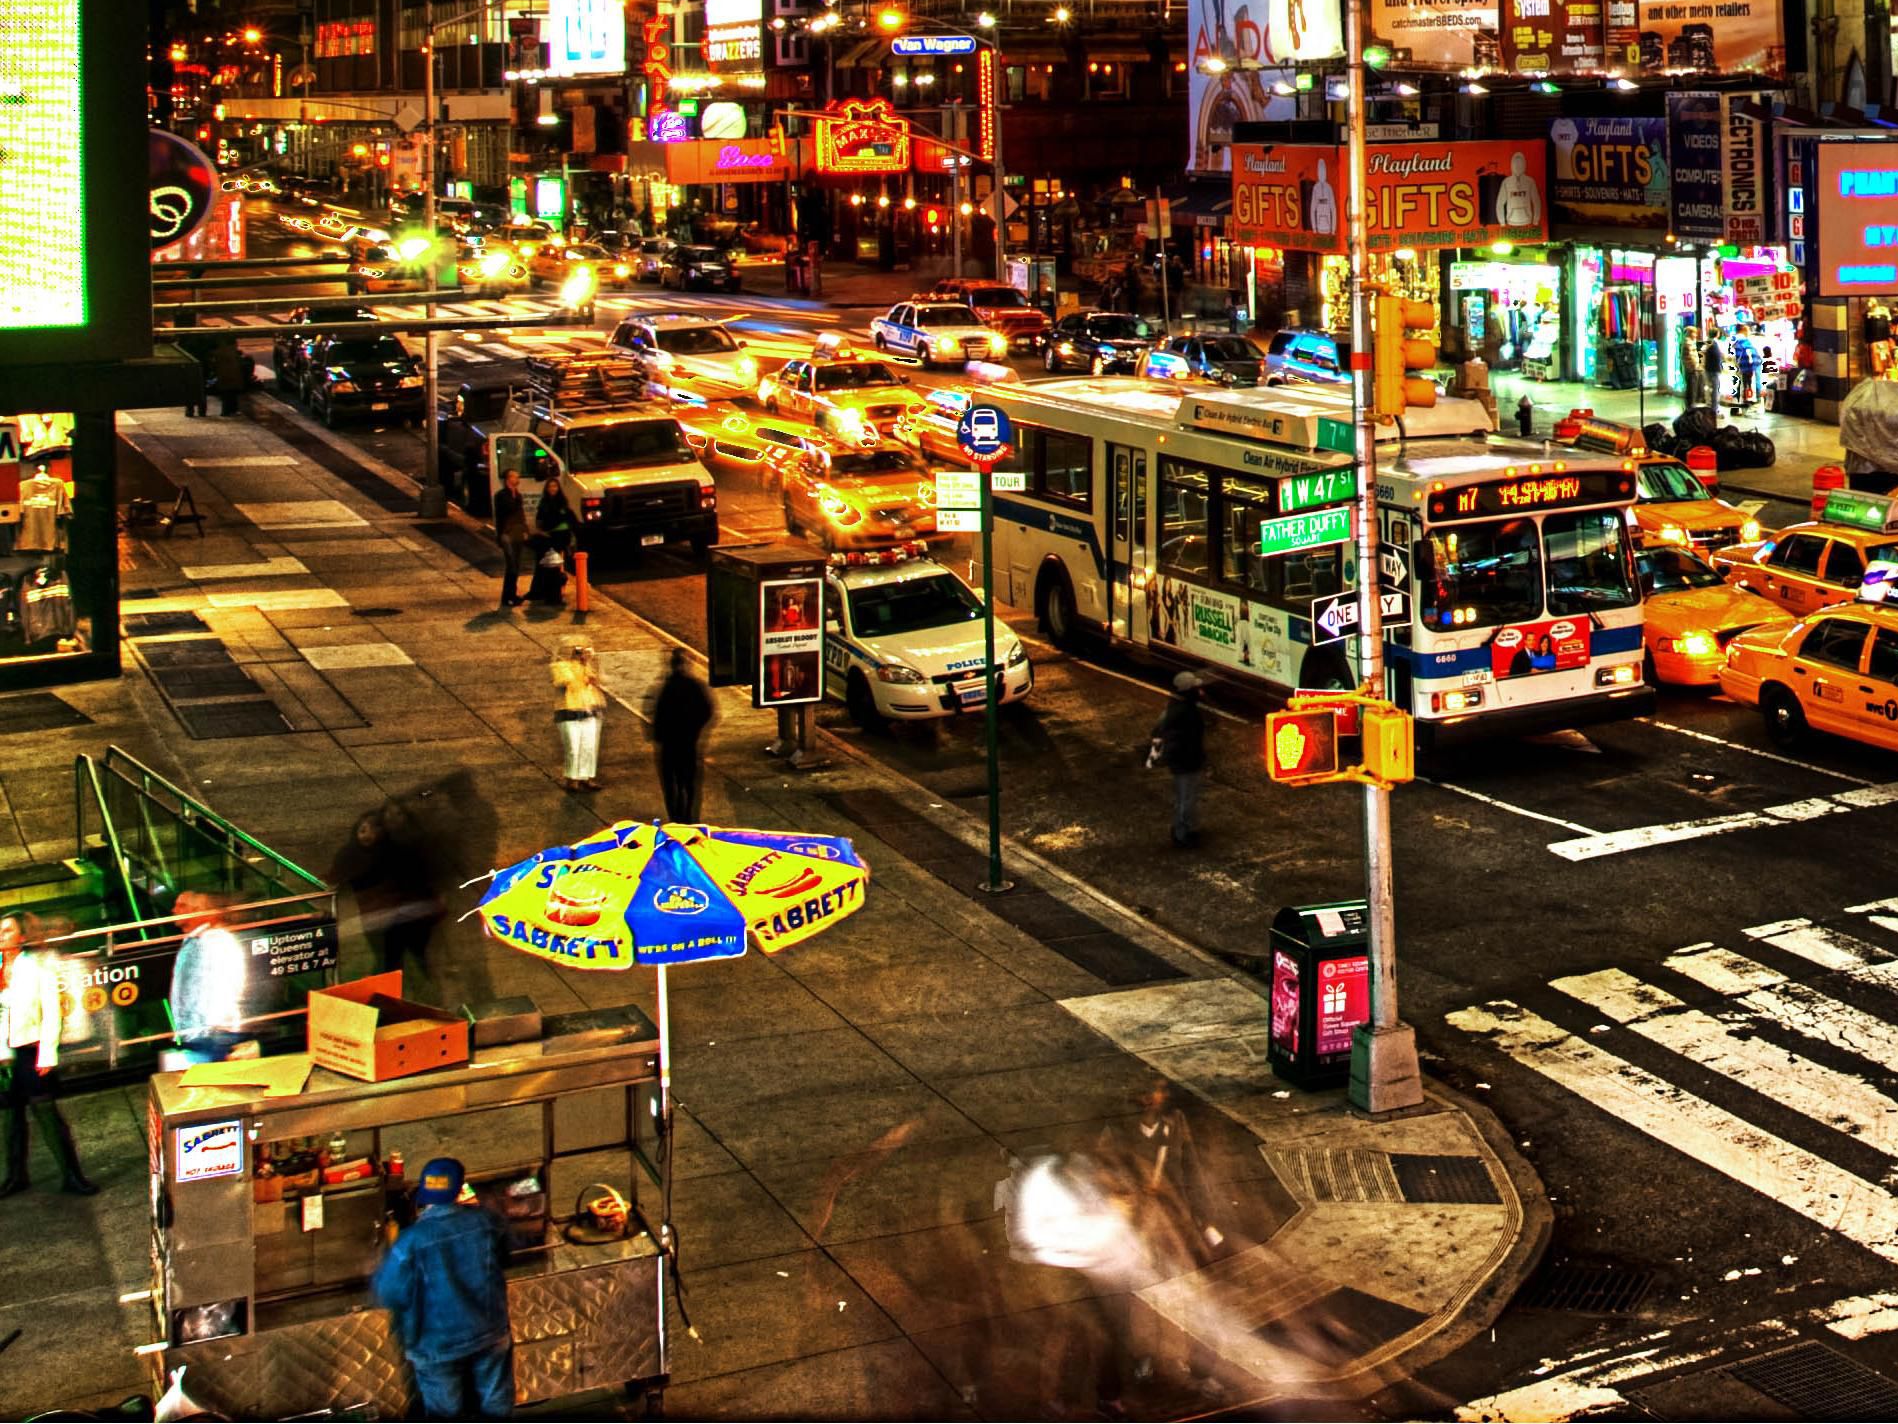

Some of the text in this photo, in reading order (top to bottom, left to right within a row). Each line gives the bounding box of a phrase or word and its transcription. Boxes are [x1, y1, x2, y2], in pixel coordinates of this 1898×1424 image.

[1648, 2, 1750, 20] and other metro retailers
[899, 37, 972, 53] Van Wagner
[1585, 119, 1633, 141] Playland
[1684, 134, 1719, 149] VIDEOS
[1244, 153, 1286, 176] Playland
[1369, 152, 1453, 178] Playland
[1571, 143, 1653, 186] GIFTS
[1236, 183, 1299, 227] GIFTS
[963, 444, 1009, 462] NO STANDING
[1244, 452, 1262, 466] Clean
[995, 476, 1020, 488] TOUR
[1297, 470, 1353, 504] W 47 ST
[1262, 510, 1348, 543] FATHER DUFFY
[1327, 606, 1352, 627] ONE
[726, 852, 783, 897] SABRETT
[753, 879, 859, 941] SABRETT
[270, 932, 312, 945] Uptown
[493, 915, 623, 960] SABRETT
[270, 942, 312, 955] Queens
[270, 947, 329, 965] elevator at
[271, 966, 285, 976] 49
[184, 1125, 240, 1153] SABRETT
